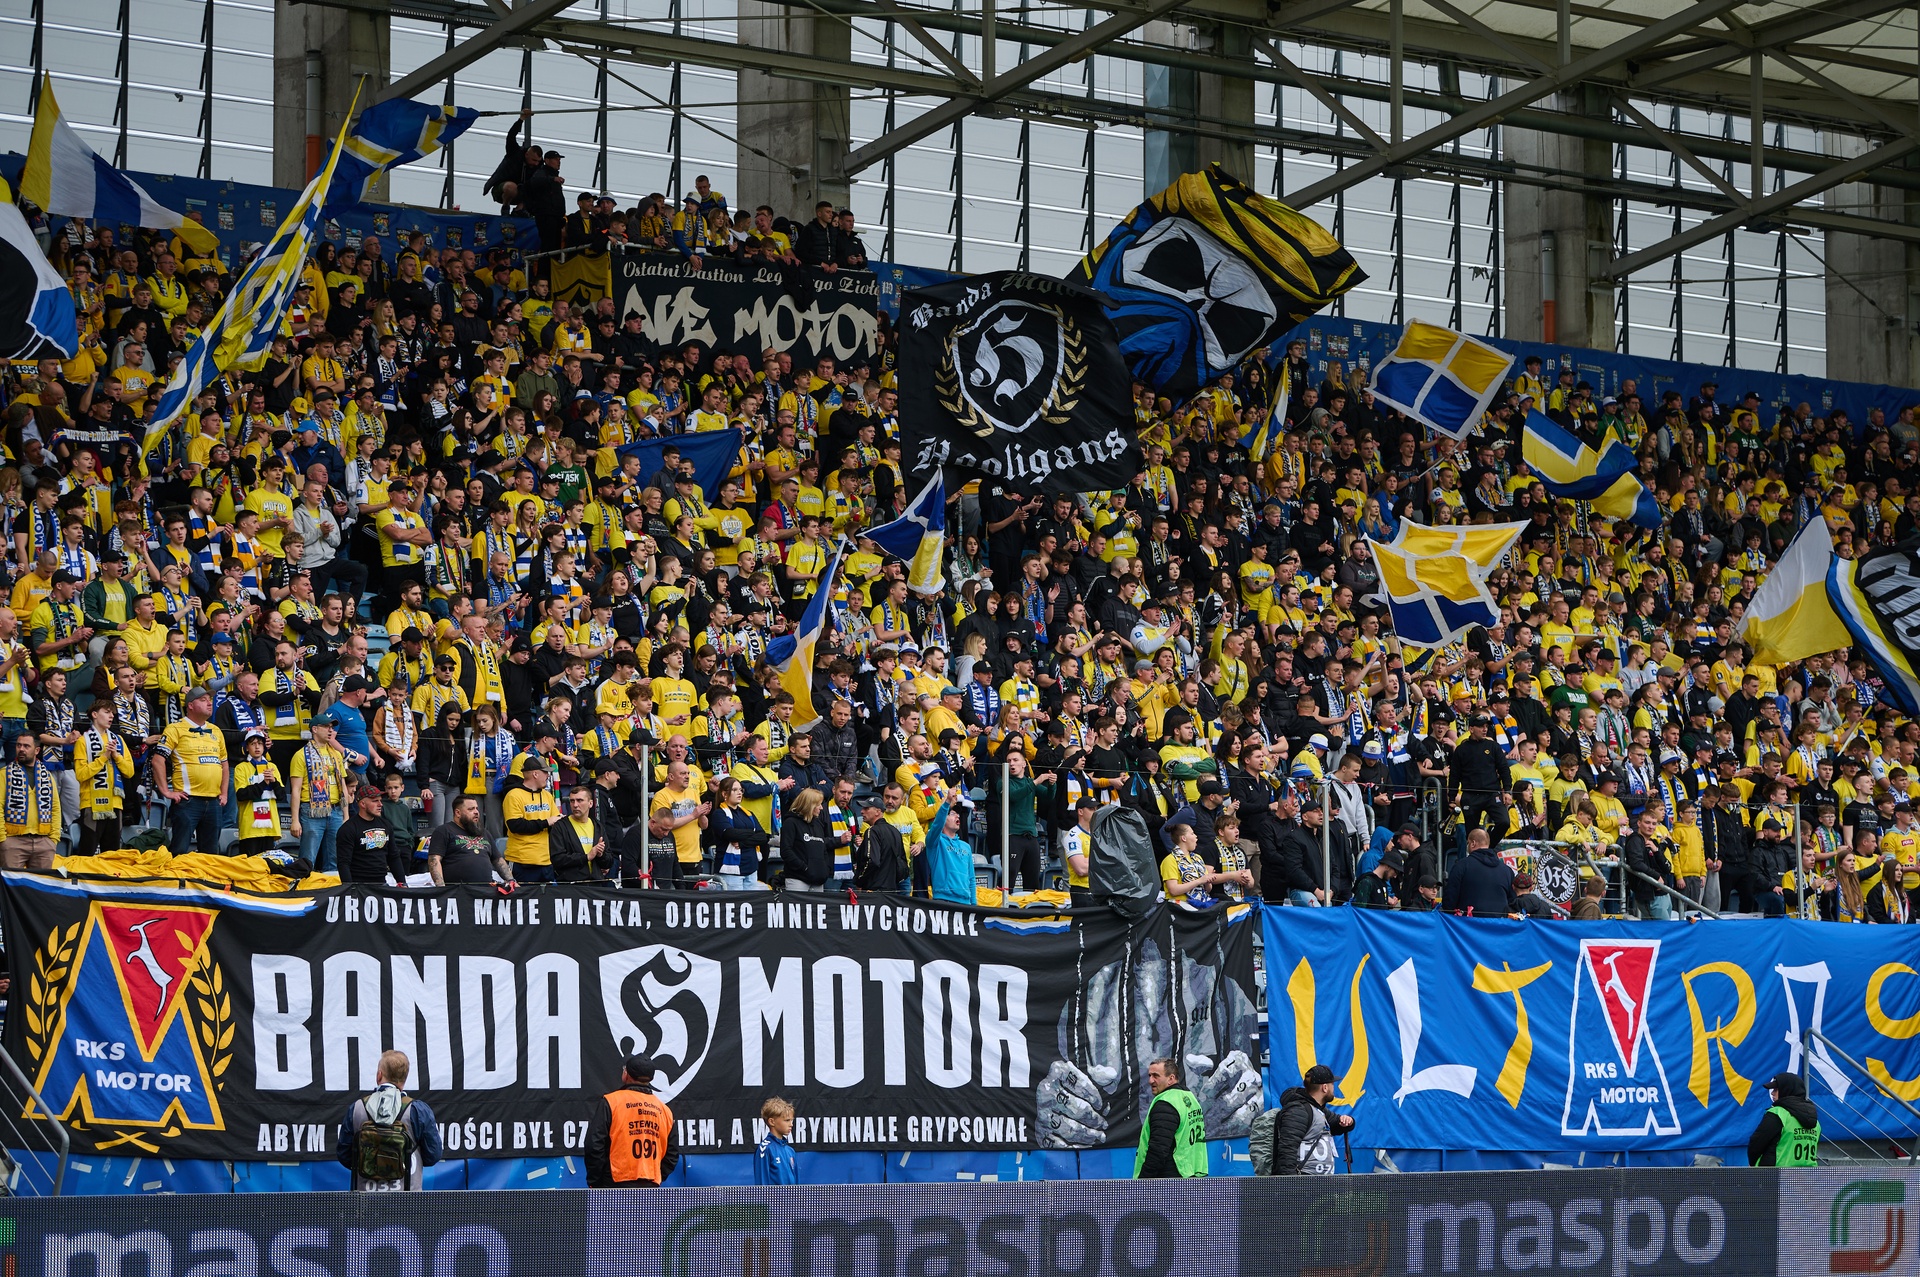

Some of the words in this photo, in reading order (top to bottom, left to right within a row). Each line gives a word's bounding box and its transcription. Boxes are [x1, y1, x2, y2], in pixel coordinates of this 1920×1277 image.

[623, 261, 680, 278] Ostatni
[682, 261, 745, 284] Bastion
[620, 283, 718, 349] AVE
[909, 281, 993, 334] Banda
[912, 427, 1129, 485] Hooligans
[88, 731, 109, 790] MTOR
[325, 895, 460, 925] URODZIŁA
[474, 897, 541, 925] MNIE
[554, 897, 652, 931] MATKA,
[665, 901, 754, 930] OJCIEC
[767, 902, 828, 930] MNIE
[839, 904, 979, 937] WYCHOWAŁ
[251, 951, 582, 1092] BANDA
[739, 955, 1031, 1089] MOTOR
[76, 1038, 125, 1061] RKS
[96, 1069, 192, 1093] MOTOR
[1584, 1061, 1618, 1079] RKS
[1188, 1109, 1204, 1119] STEW
[1600, 1086, 1659, 1105] MOTOR
[257, 1122, 326, 1152] ABYM
[513, 1121, 554, 1149] BYŁ
[730, 1118, 744, 1145] A
[907, 1115, 1028, 1144] GRYPSOWAŁ
[1794, 1143, 1817, 1161] 019
[1406, 1195, 1727, 1277] maspo
